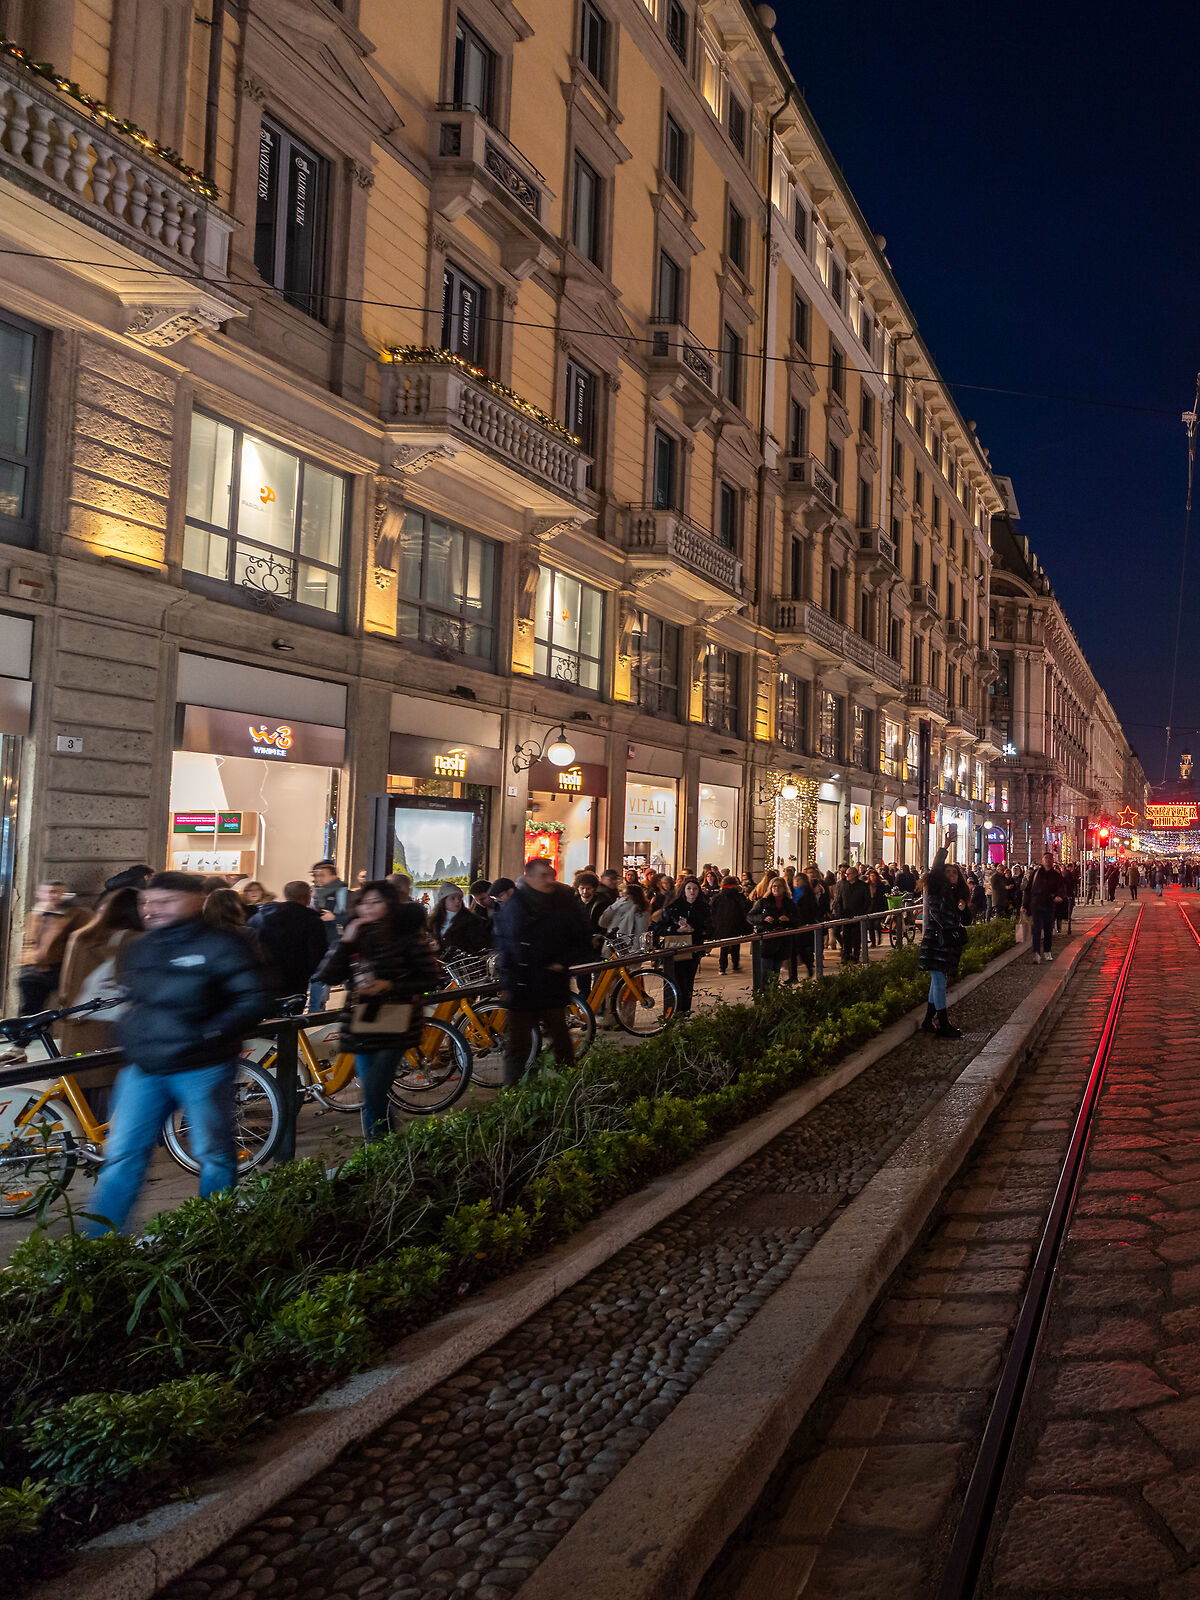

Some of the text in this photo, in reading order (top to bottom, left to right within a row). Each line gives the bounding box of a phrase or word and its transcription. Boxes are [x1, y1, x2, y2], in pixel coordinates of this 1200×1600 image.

[259, 142, 271, 200] SOLUZIONI
[296, 207, 305, 226] PER
[462, 301, 471, 346] LOMBARDA
[67, 739, 74, 749] 3
[434, 753, 467, 770] nashi
[558, 770, 582, 785] nashi
[629, 797, 666, 815] VITALI
[1146, 805, 1199, 819] STRANGER
[1153, 816, 1191, 827] THINGS
